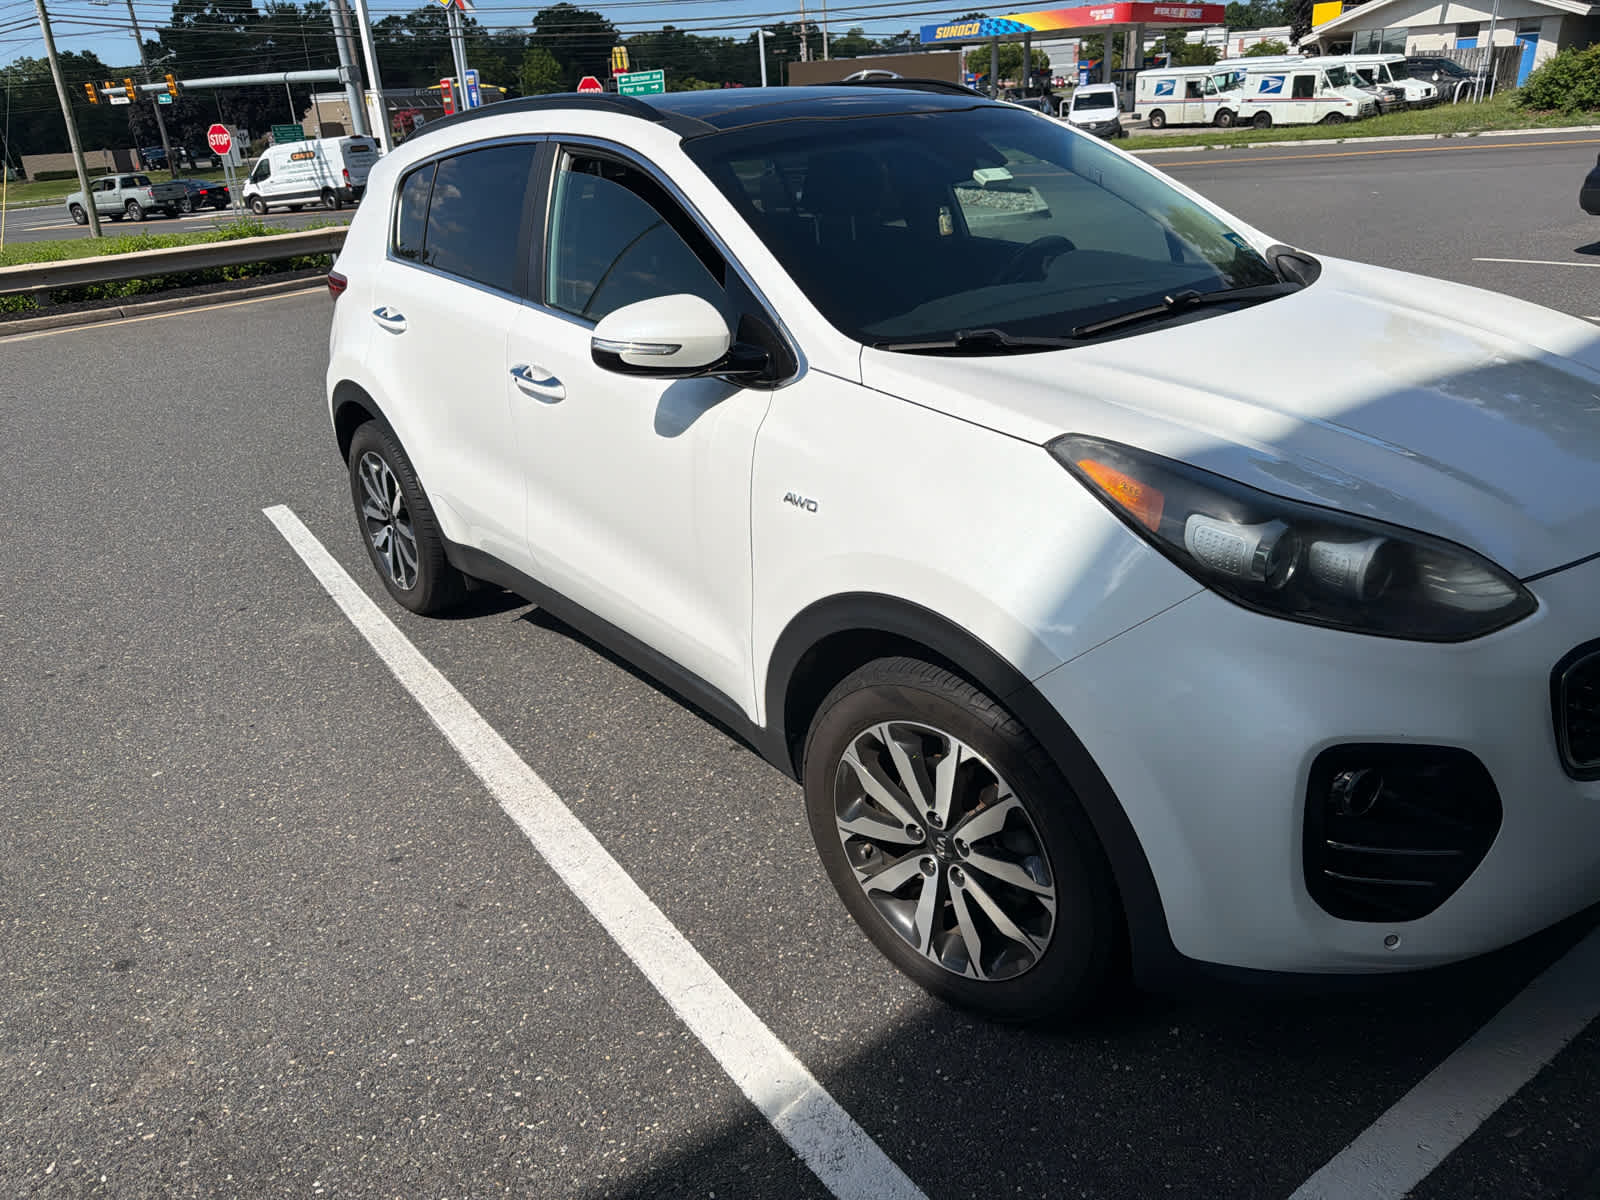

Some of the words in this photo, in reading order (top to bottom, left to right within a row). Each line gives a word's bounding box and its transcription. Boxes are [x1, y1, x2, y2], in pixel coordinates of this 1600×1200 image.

[935, 23, 981, 39] SUNOCO
[209, 133, 229, 146] STOP
[783, 492, 818, 513] AWD
